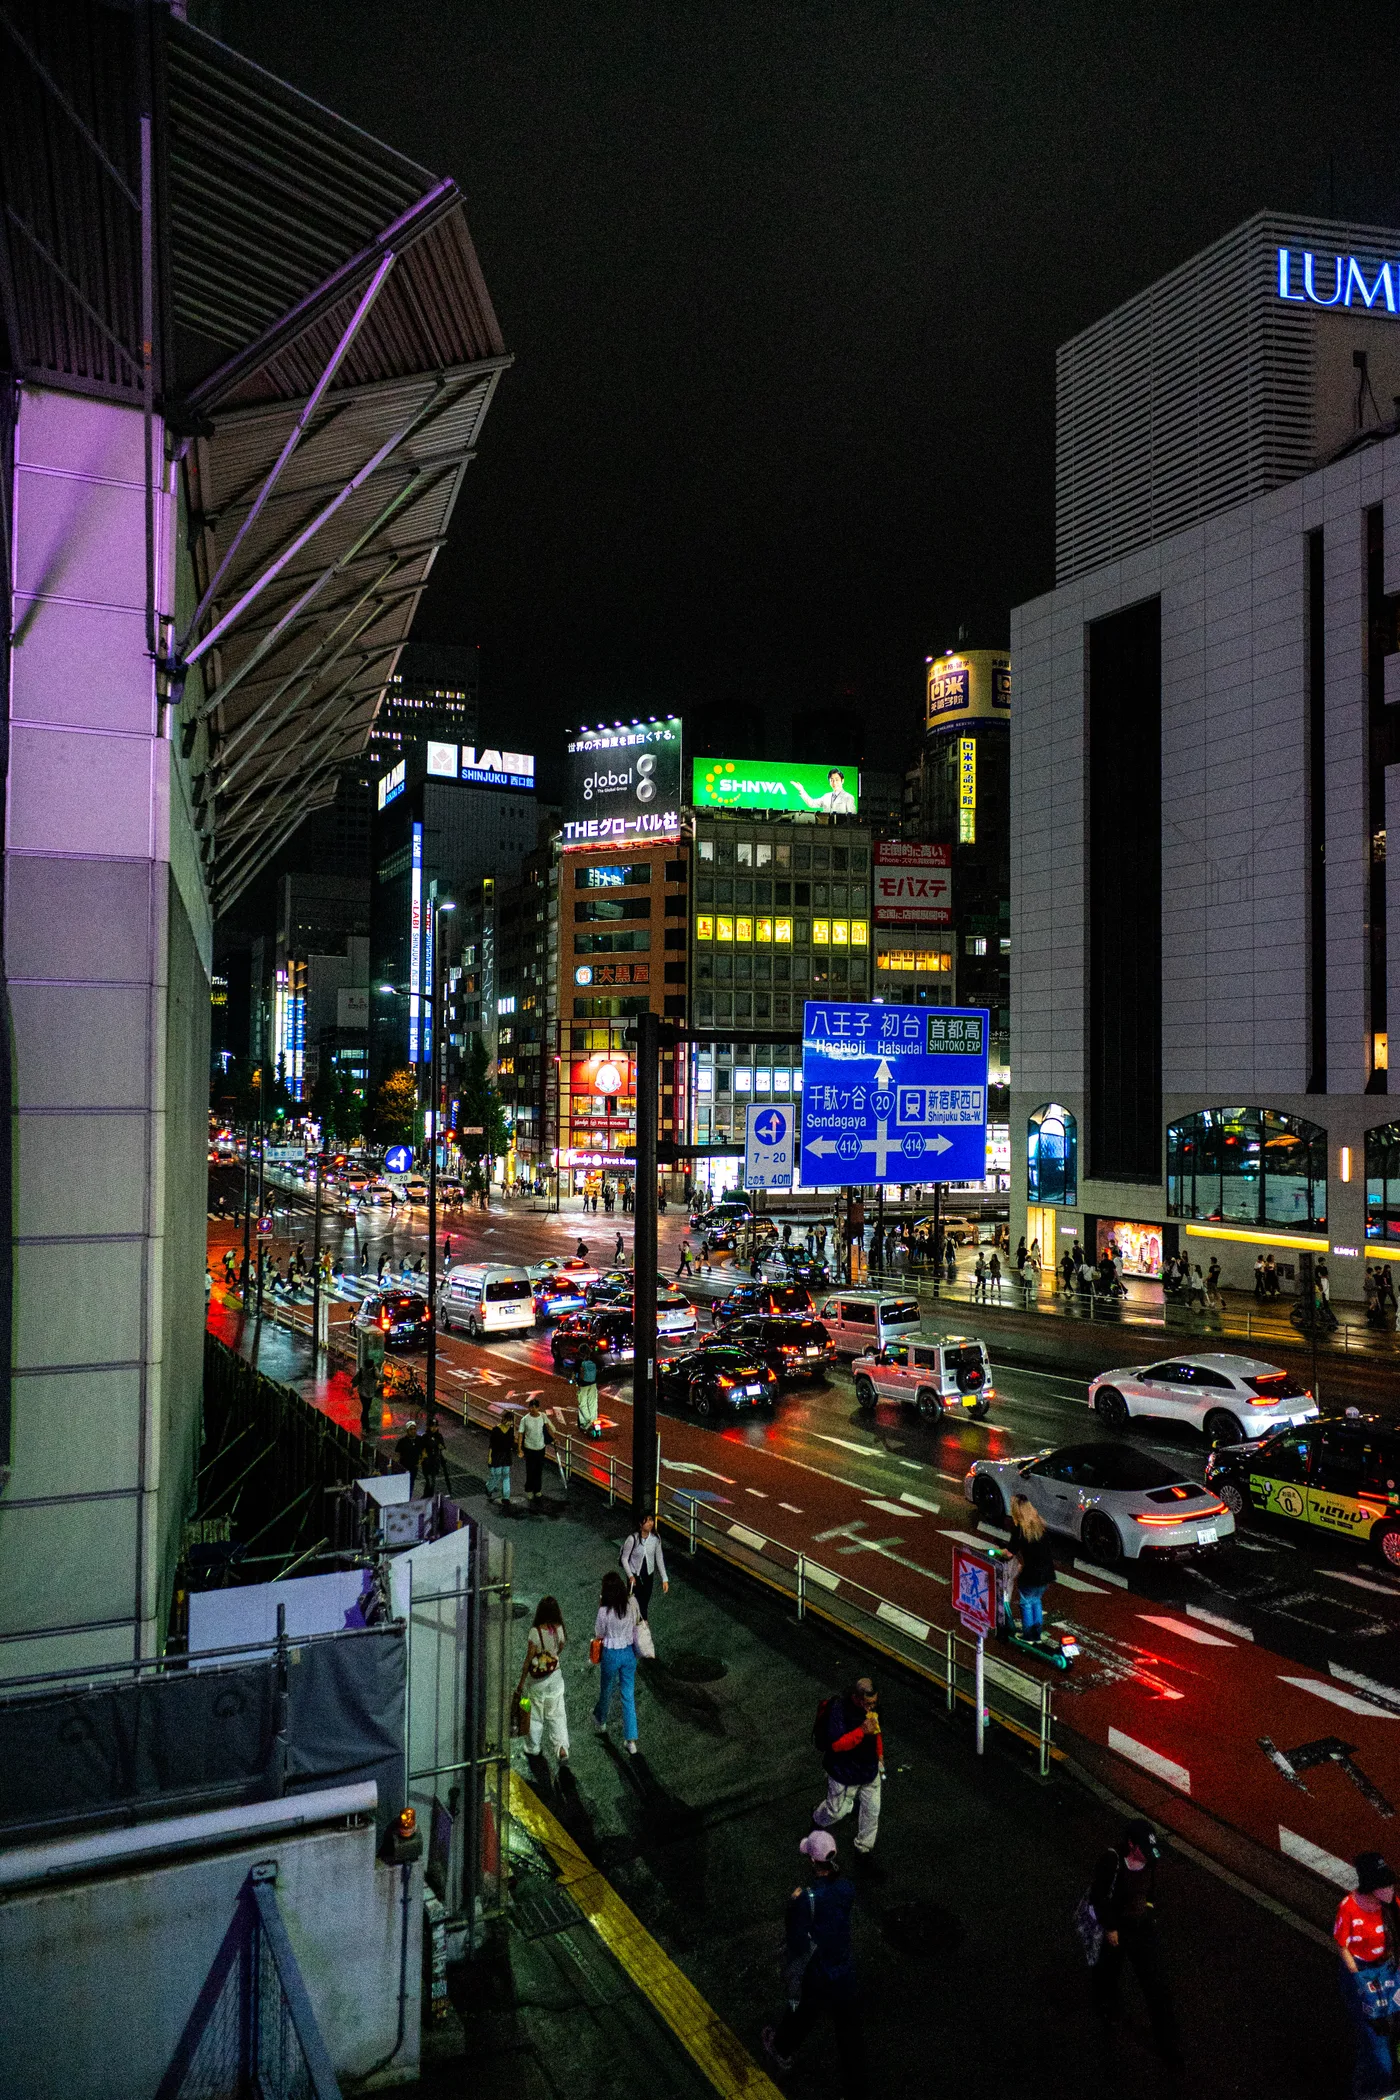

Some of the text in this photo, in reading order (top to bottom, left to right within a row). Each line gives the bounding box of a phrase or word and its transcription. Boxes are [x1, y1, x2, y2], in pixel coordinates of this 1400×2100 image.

[1277, 247, 1400, 313] LUM
[461, 745, 535, 776] LABI
[461, 768, 507, 785] SHINJUKU
[583, 767, 633, 800] global
[563, 811, 678, 839] THEグローバル社
[879, 843, 947, 858] 圧倒的に高い。
[879, 876, 948, 898] モバステ
[598, 965, 650, 984] 大黒屋
[811, 1011, 981, 1040] 八王子 初台 首都高
[816, 1039, 981, 1055] Hachioji Hatsudai SHUTOKO EXP
[875, 1096, 890, 1109] 20
[928, 1090, 981, 1110] 新宿駅西口
[806, 1114, 867, 1129] Sendagaya
[928, 1110, 958, 1123] Shinjuku
[840, 1140, 858, 1153] 414
[905, 1138, 922, 1151] 414
[771, 1173, 791, 1185] 40m
